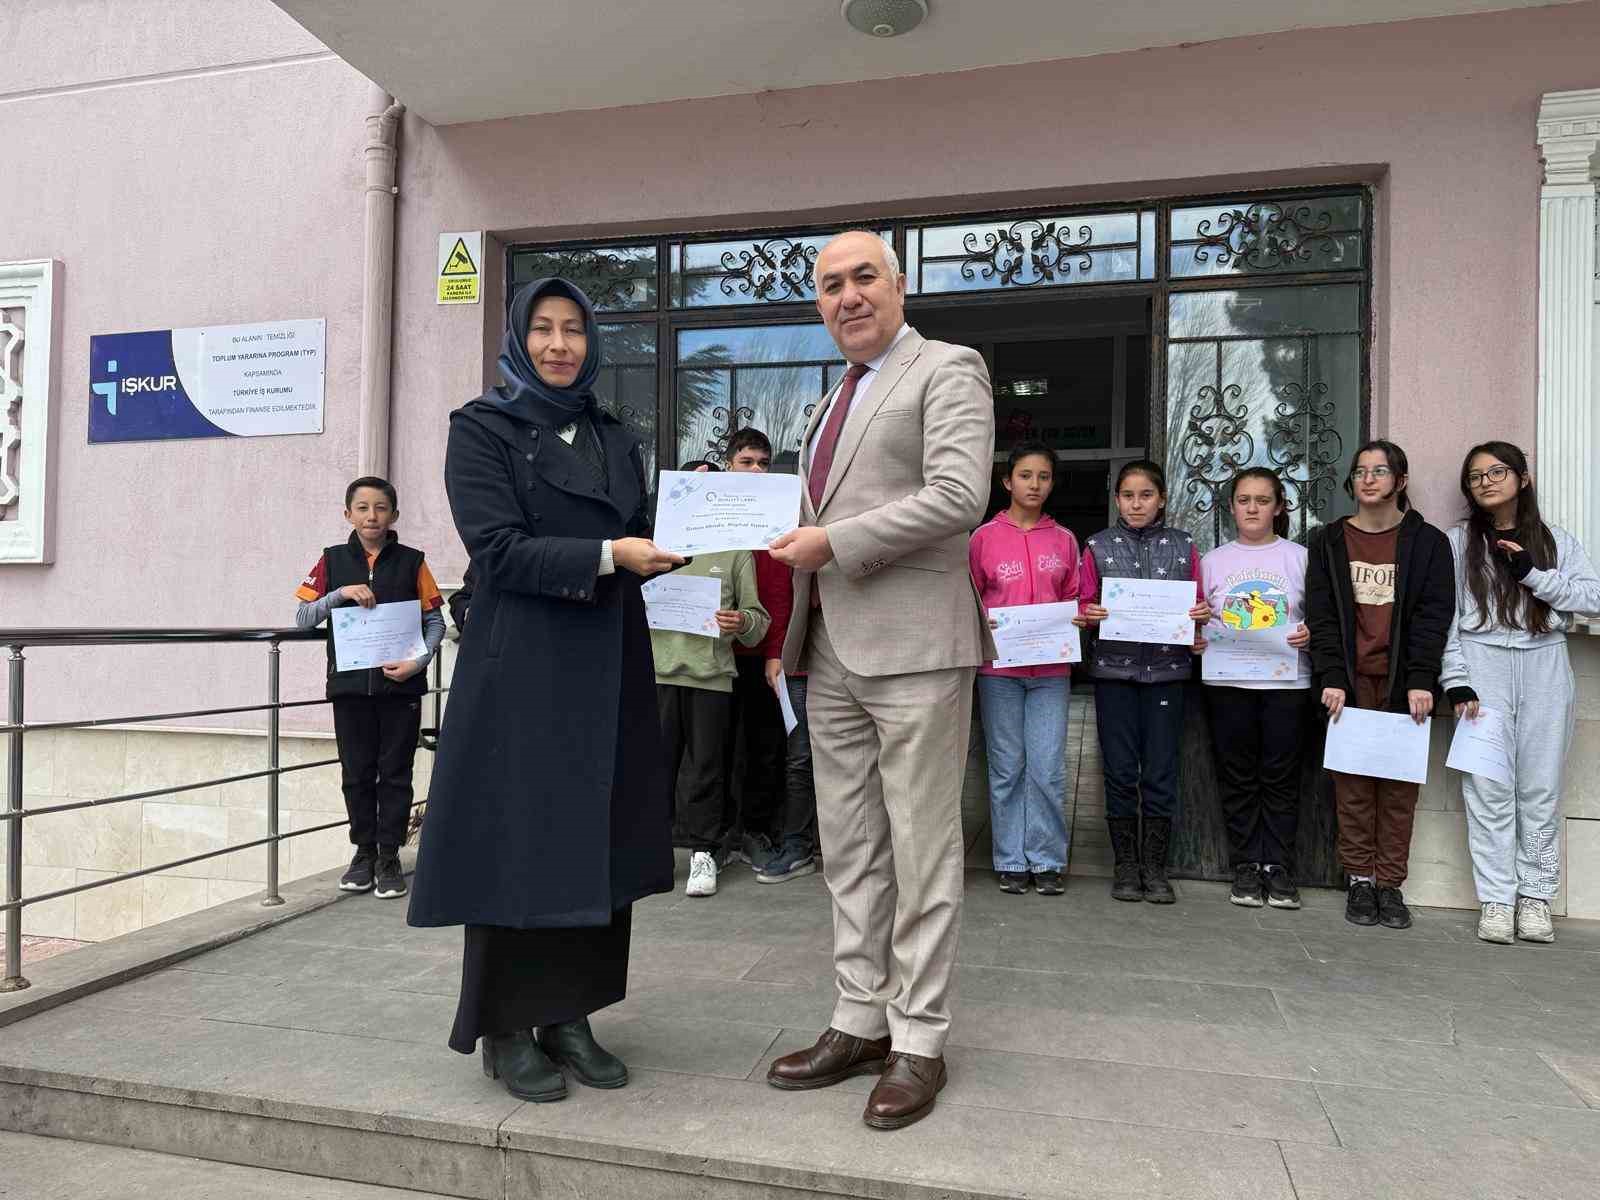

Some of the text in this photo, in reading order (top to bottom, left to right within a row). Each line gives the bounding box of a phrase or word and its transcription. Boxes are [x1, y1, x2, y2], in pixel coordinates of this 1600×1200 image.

[241, 334, 263, 343] ALANIN
[212, 348, 317, 363] TOPLUM YARARINA PROGRAM (TYP)
[243, 368, 283, 378] KAPSAMINDA
[233, 386, 258, 397] TÜRKİYE
[266, 386, 293, 395] KURUMU
